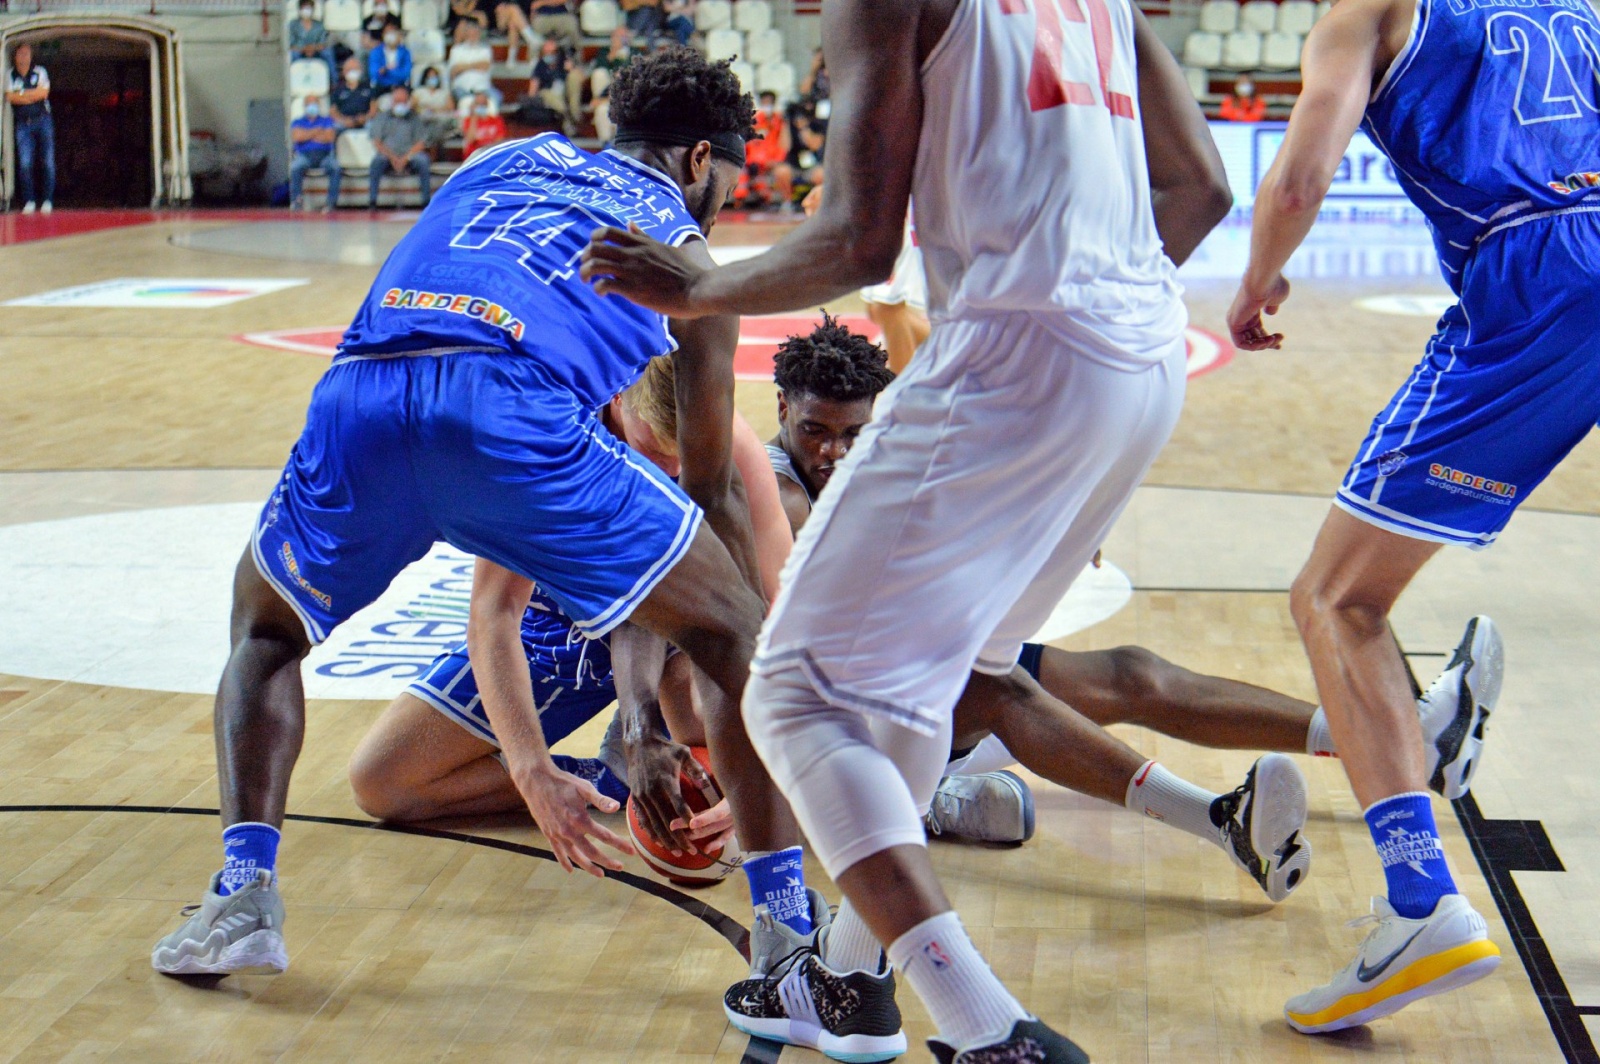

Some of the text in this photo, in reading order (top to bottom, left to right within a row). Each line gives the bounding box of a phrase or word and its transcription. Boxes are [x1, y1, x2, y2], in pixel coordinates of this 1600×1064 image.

[586, 166, 676, 222] REALE
[381, 288, 526, 342] SARDEGNA
[1429, 463, 1517, 499] SARDEGNA
